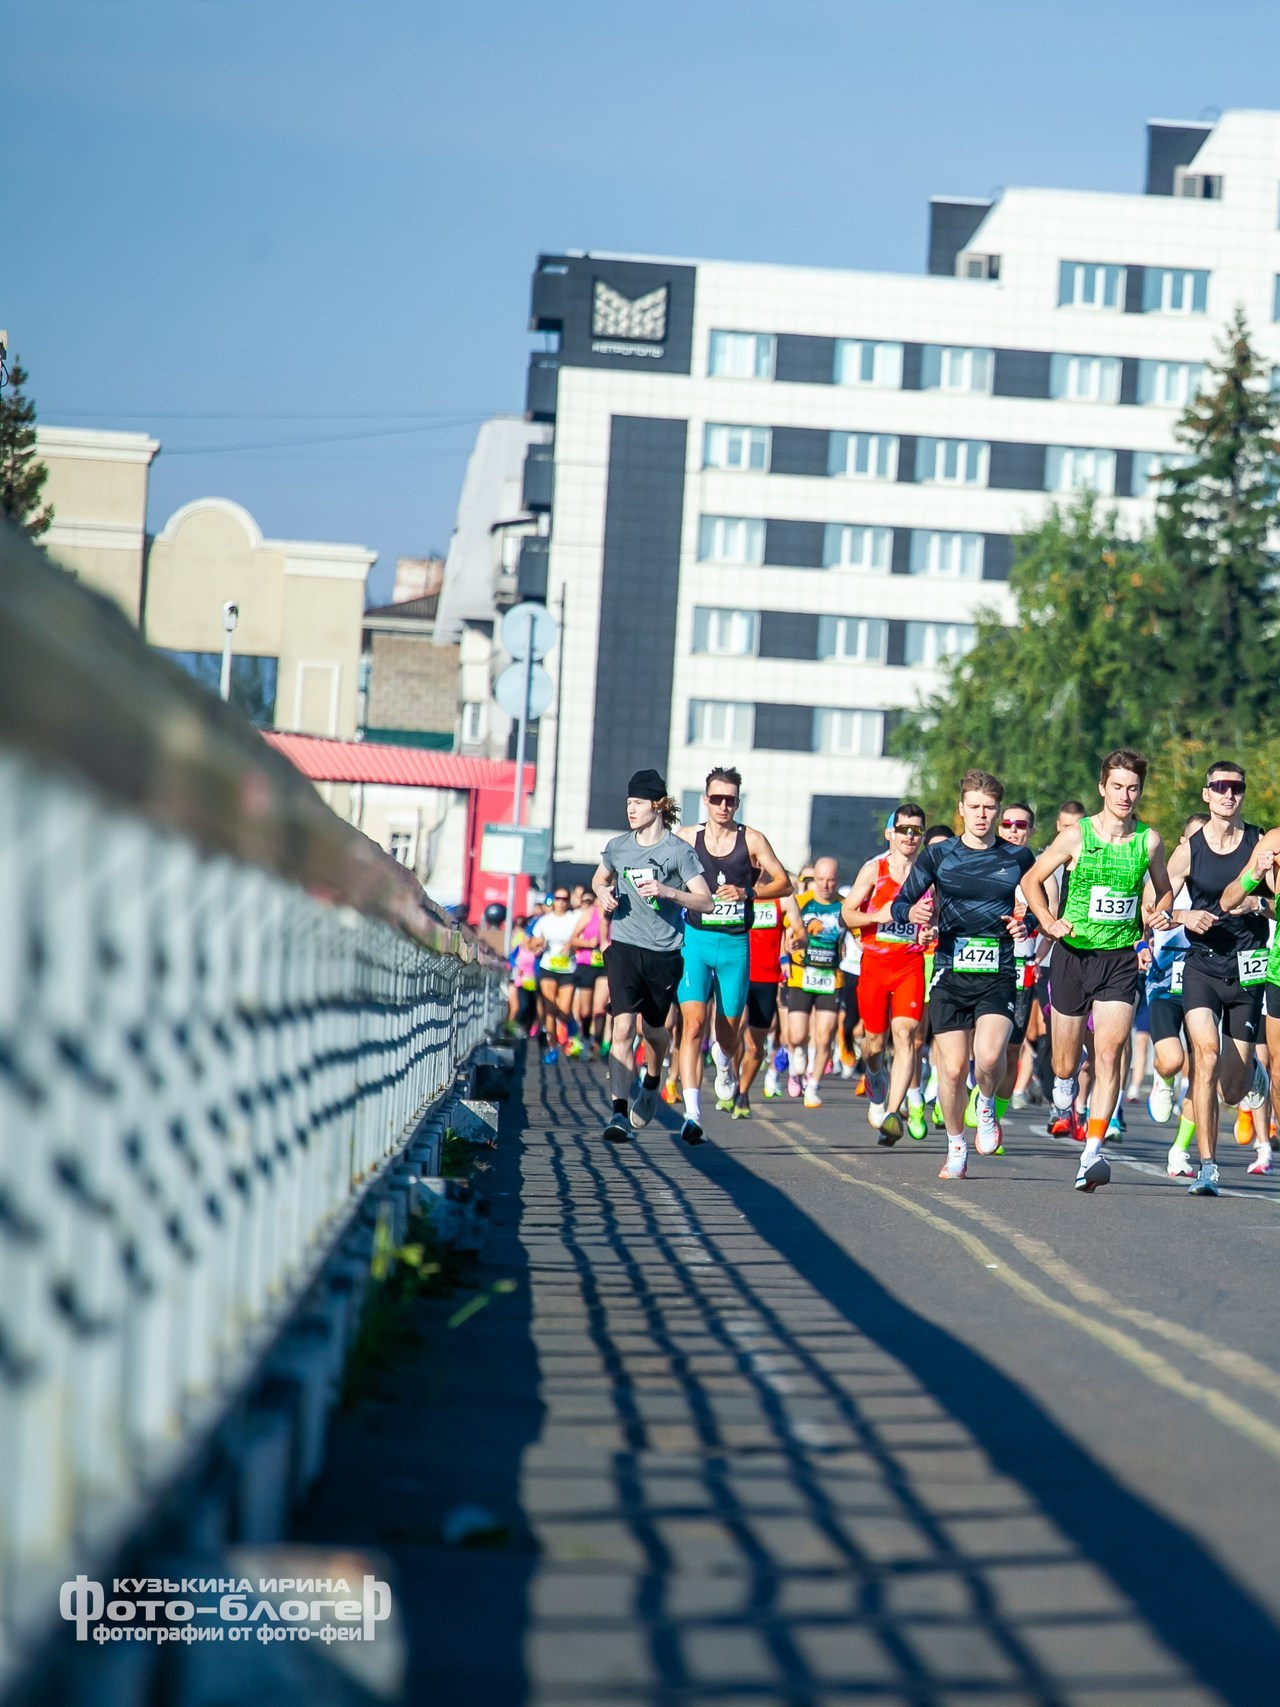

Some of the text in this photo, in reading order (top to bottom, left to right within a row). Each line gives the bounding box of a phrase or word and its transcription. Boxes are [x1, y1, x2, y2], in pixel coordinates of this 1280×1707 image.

[711, 904, 739, 915] 271
[1095, 898, 1135, 914] 1337
[879, 922, 915, 935] 1498
[957, 949, 995, 962] 1474
[806, 975, 832, 987] 1340
